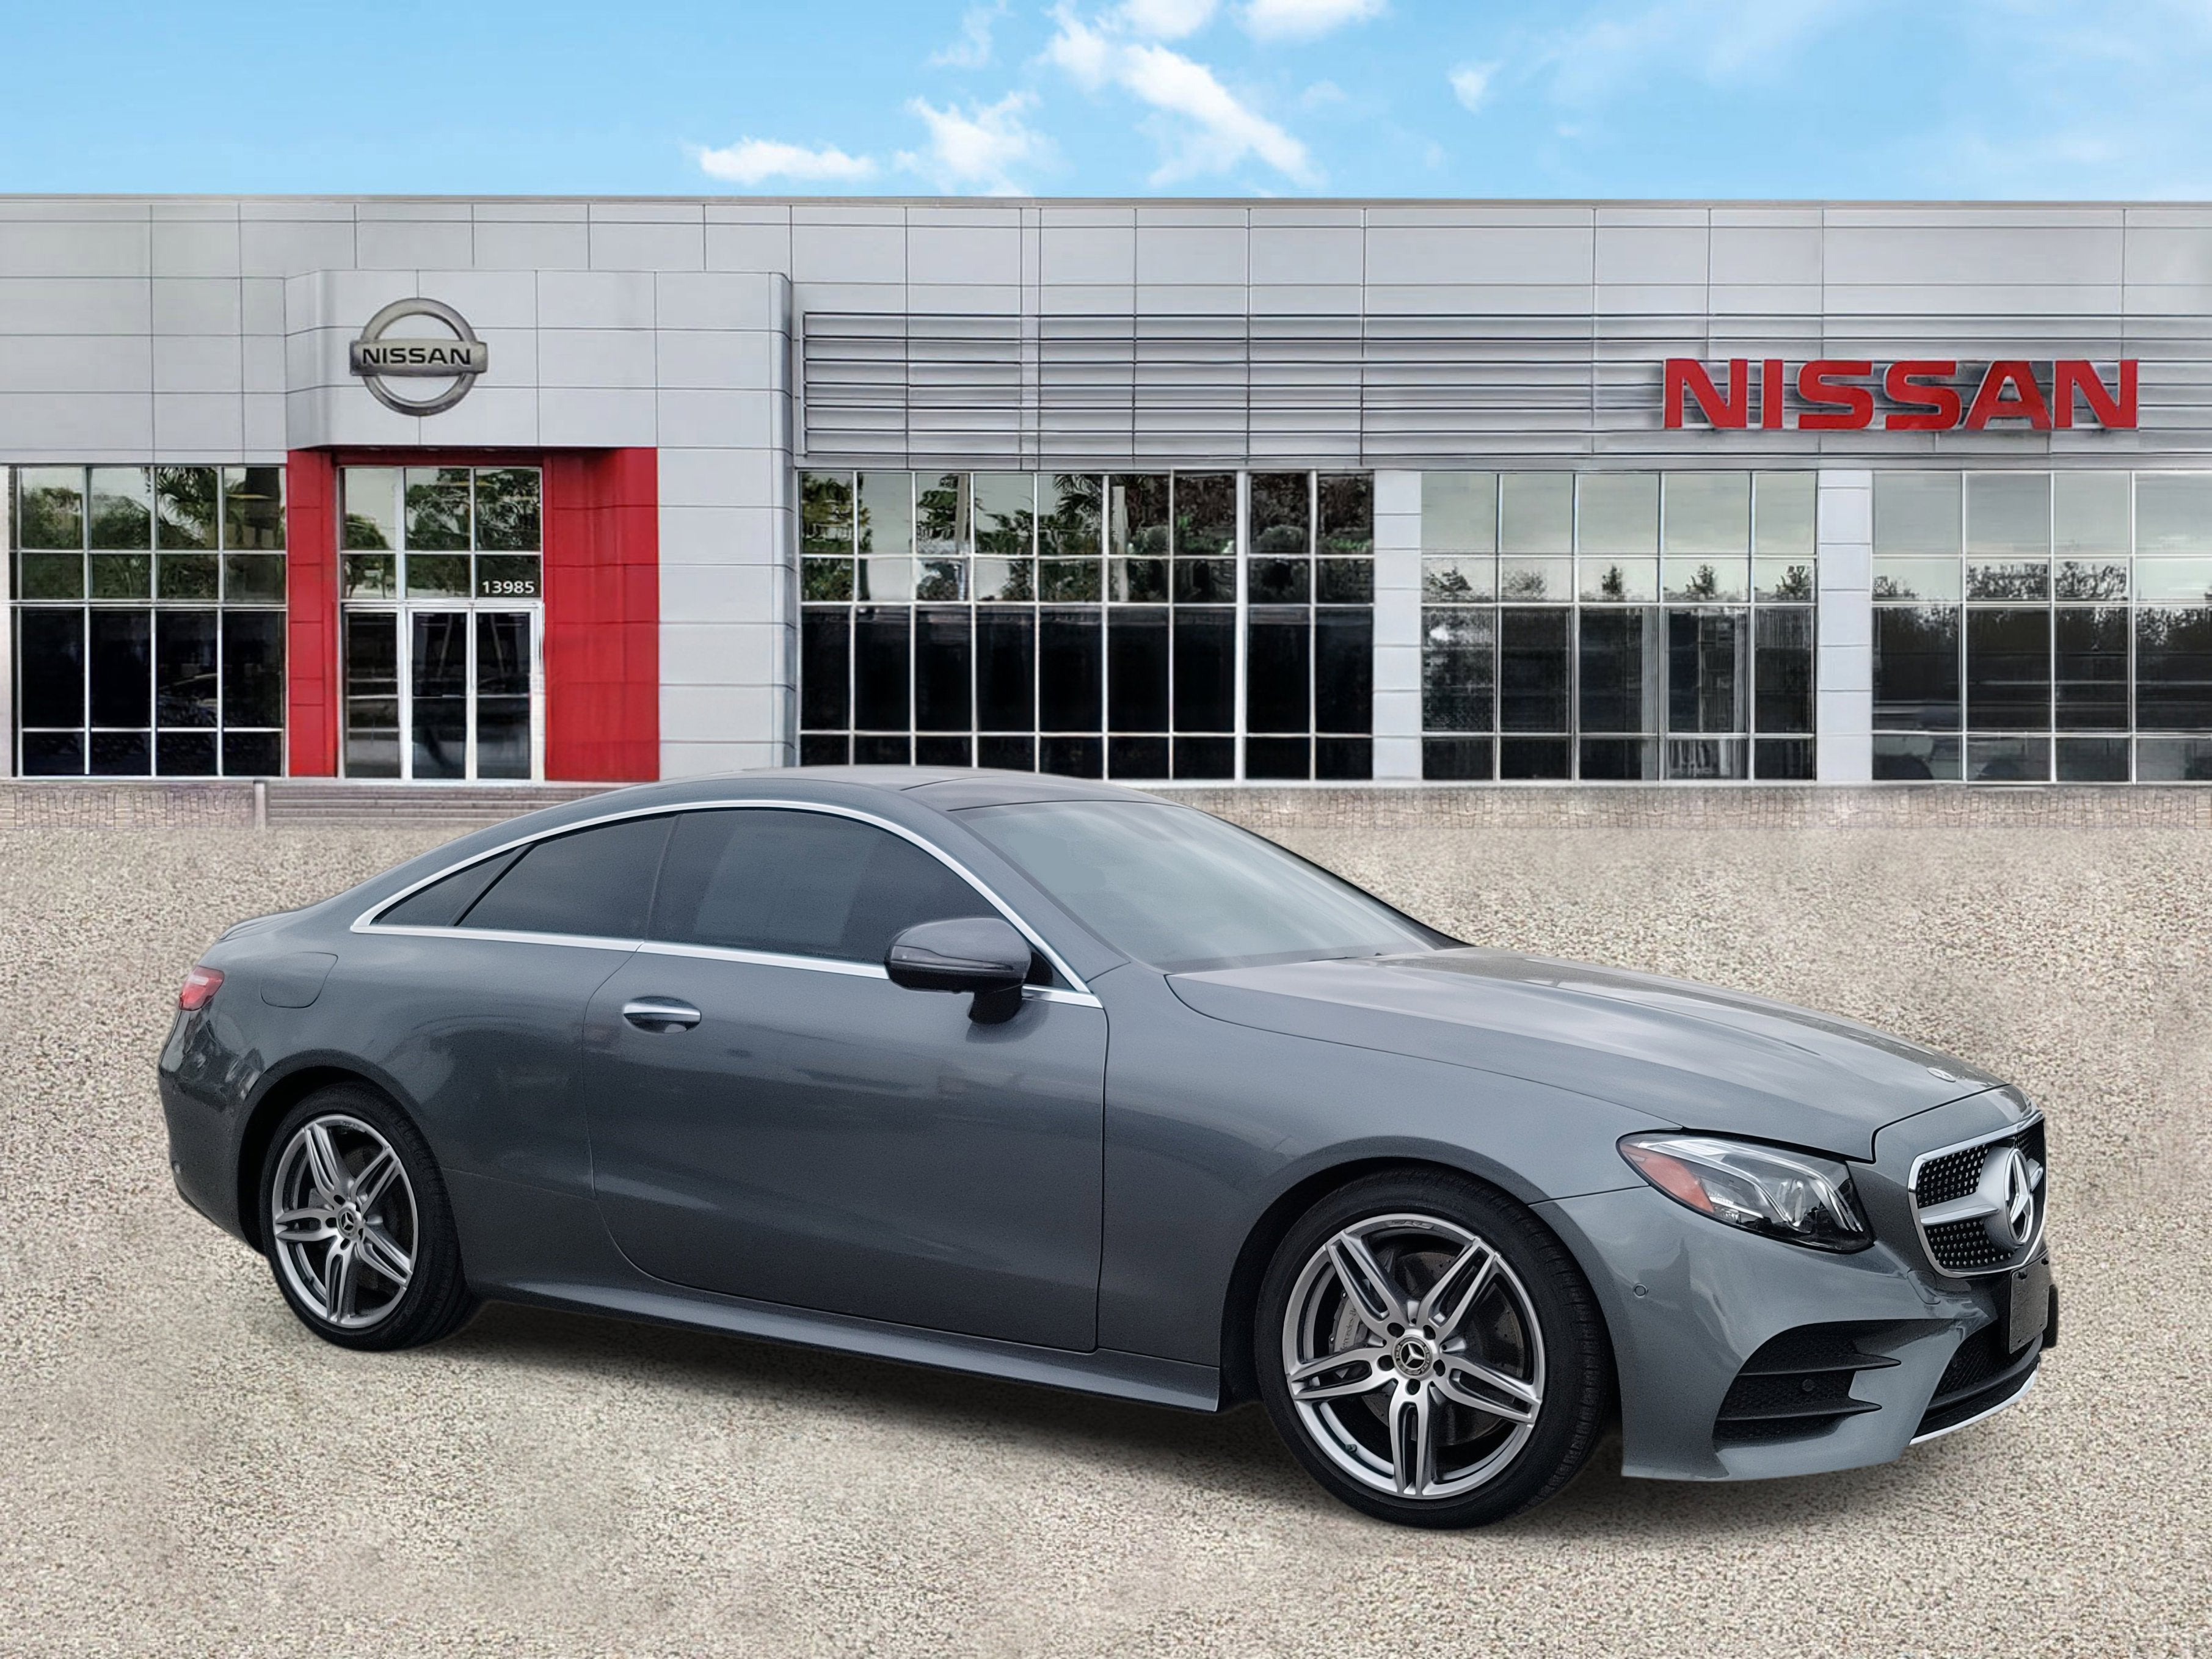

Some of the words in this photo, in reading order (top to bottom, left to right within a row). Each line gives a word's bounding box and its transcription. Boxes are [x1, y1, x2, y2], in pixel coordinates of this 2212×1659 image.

[362, 348, 471, 365] NISSAN
[1664, 359, 2139, 429] NISSAN
[482, 580, 535, 594] 13985
